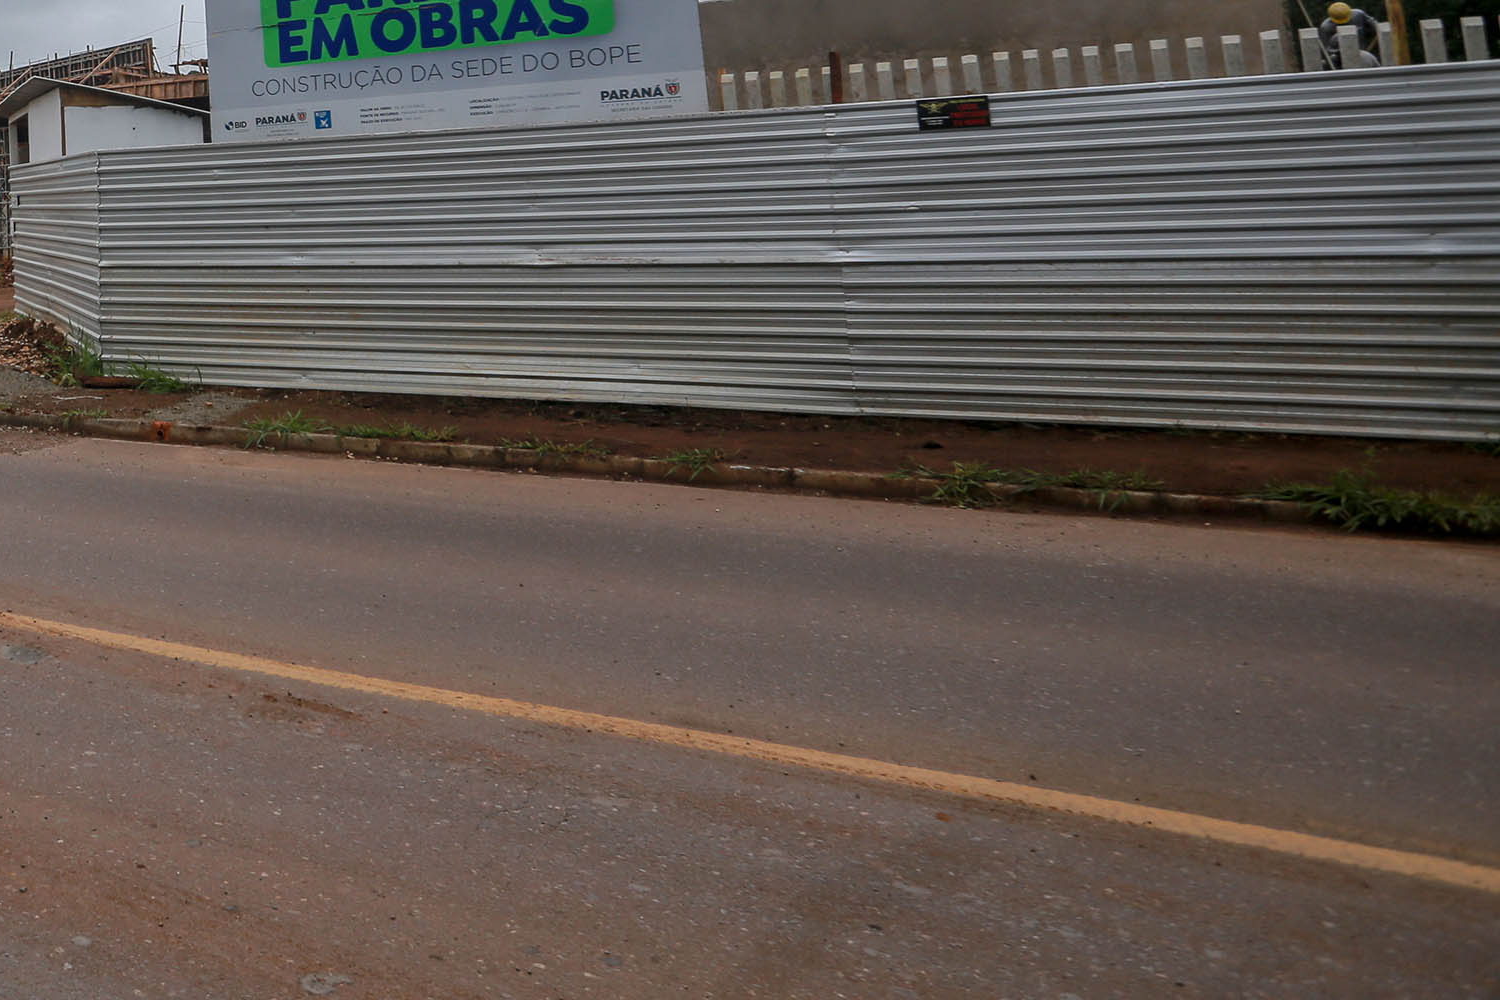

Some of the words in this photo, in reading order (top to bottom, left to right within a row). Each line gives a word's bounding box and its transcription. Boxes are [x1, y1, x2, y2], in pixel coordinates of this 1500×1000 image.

[277, 13, 359, 63] EM
[251, 65, 402, 97] CONSTRUÇÃO
[411, 64, 443, 82] DA
[451, 56, 512, 78] SEDE
[522, 51, 560, 71] DO
[569, 44, 642, 67] BOPE
[600, 84, 664, 101] PARANÁ
[234, 121, 247, 129] BID
[255, 113, 296, 125] PARANÁ
